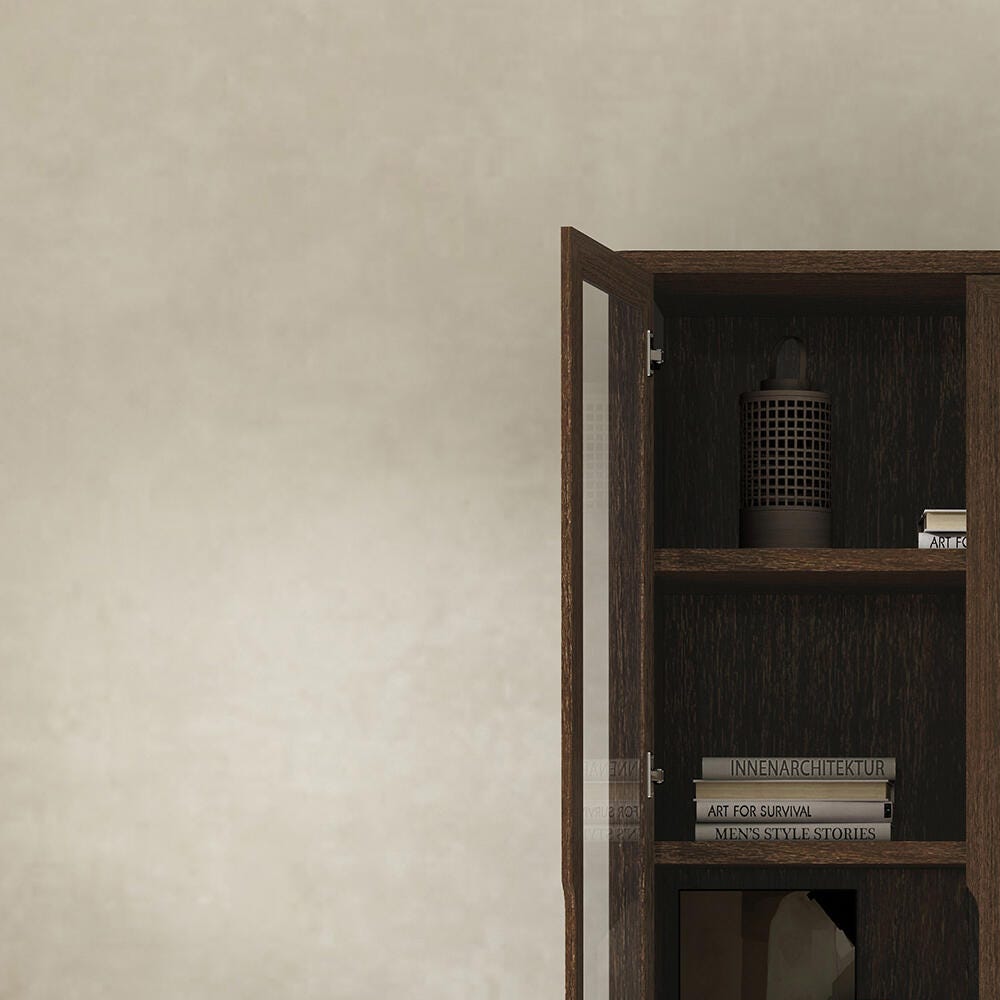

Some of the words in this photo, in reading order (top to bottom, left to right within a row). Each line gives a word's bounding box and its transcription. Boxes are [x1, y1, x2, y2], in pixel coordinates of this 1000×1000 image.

[930, 536, 950, 549] ART
[955, 536, 967, 549] FO
[730, 759, 886, 777] INNENARCHITEKTUR
[707, 805, 729, 818] ART
[733, 805, 757, 818] FOR
[760, 805, 812, 818] SURVIVAL
[715, 827, 760, 841] MEN'S
[764, 827, 811, 841] STYLE
[813, 827, 876, 841] STORIES
